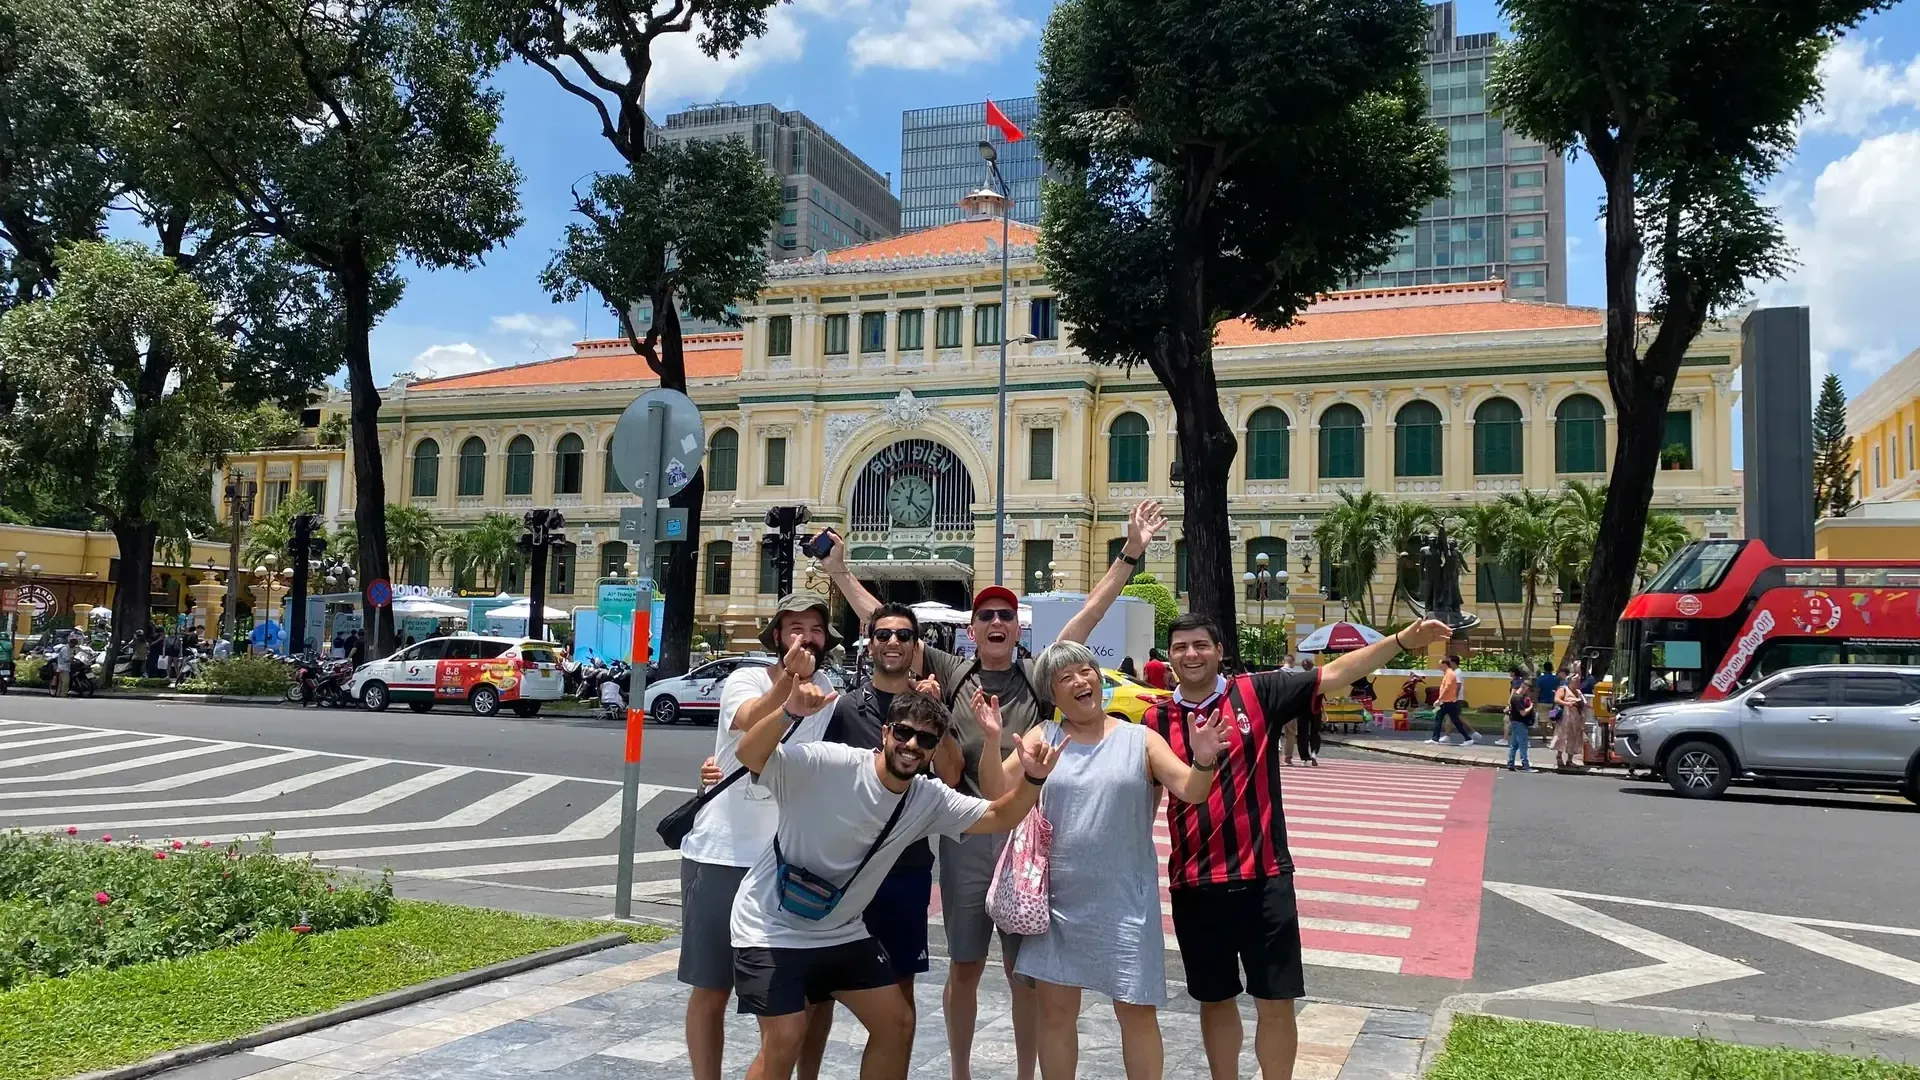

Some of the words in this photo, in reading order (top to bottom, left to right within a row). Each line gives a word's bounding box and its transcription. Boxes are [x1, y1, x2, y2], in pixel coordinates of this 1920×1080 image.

[391, 583, 429, 598] HONOR
[1092, 645, 1115, 658] X6c
[1715, 668, 1732, 690] Hop
[1732, 657, 1743, 670] on
[1742, 633, 1760, 652] Hop
[1757, 612, 1774, 633] Off
[445, 667, 459, 675] 8.8
